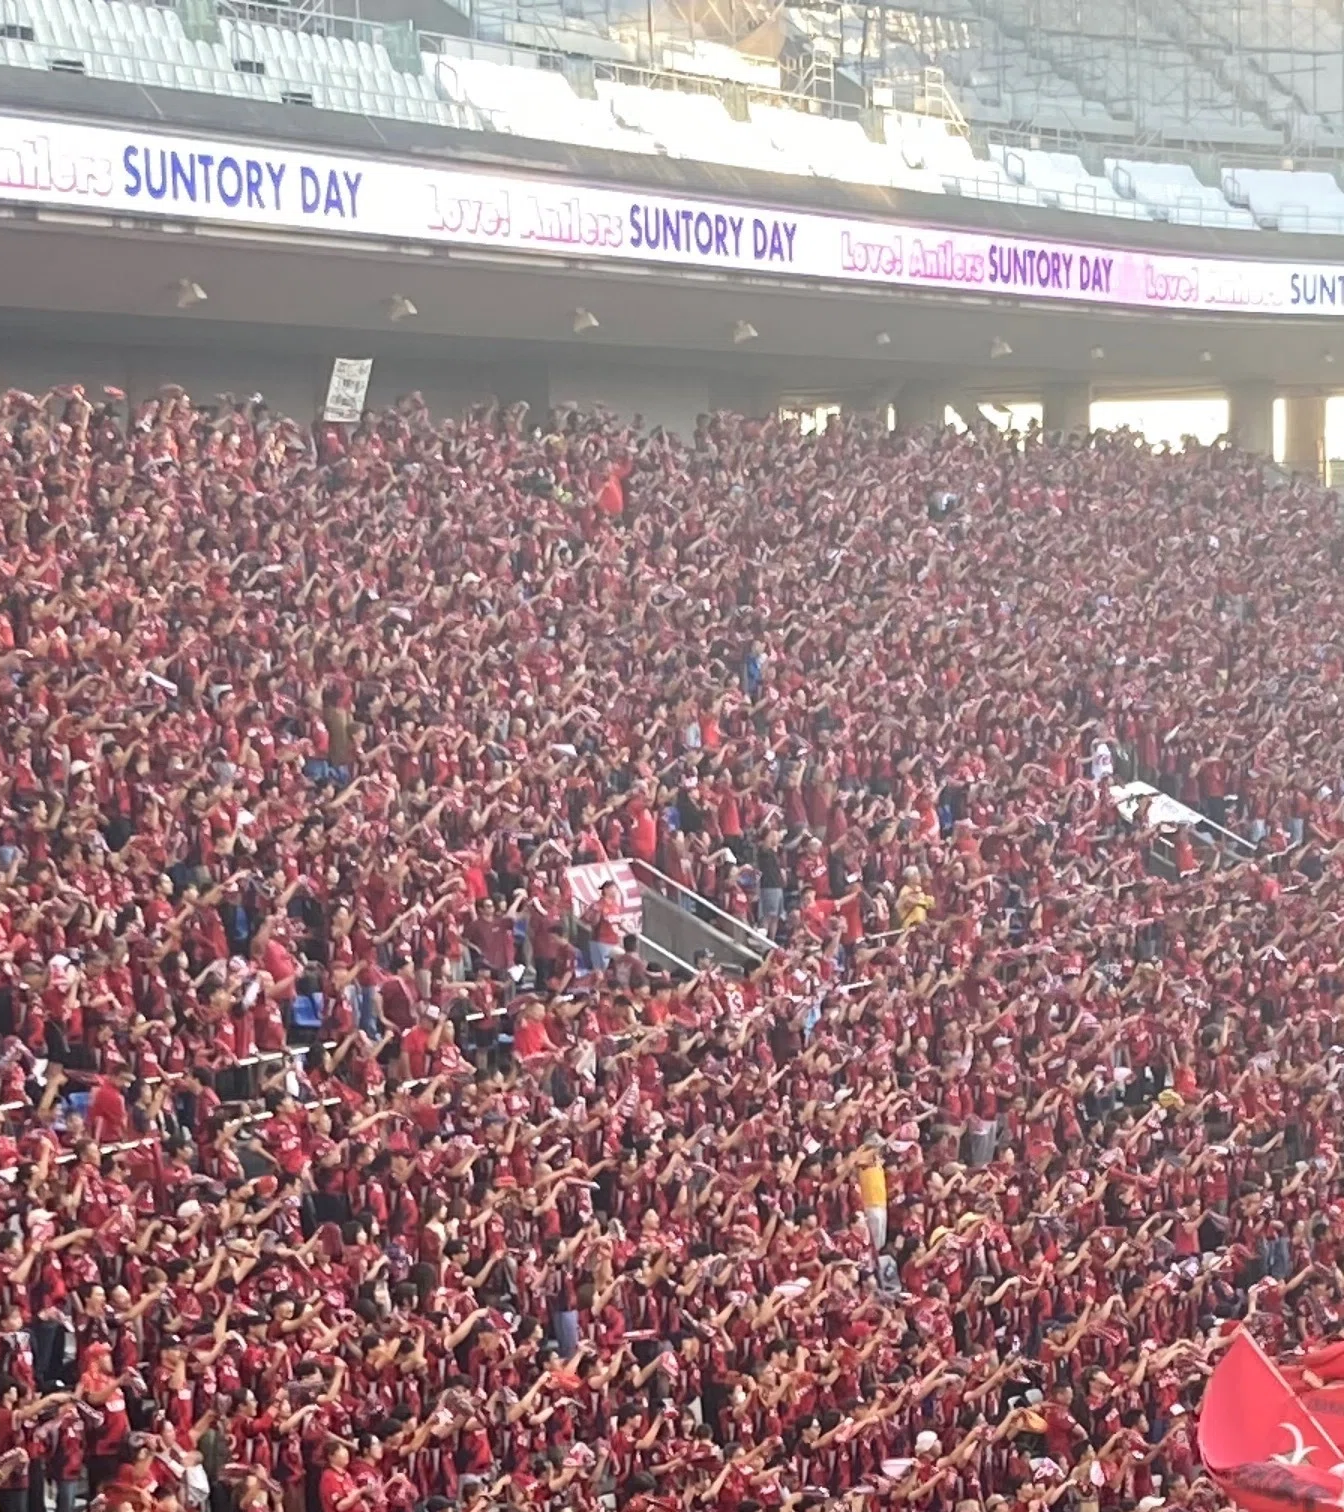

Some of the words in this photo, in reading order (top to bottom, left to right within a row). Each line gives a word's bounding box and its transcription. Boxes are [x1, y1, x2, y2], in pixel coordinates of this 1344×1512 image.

[122, 144, 285, 213] SUNTORY
[301, 168, 364, 221] DAY
[629, 203, 745, 258] SUNTORY
[753, 218, 798, 263] DAY
[987, 244, 1074, 289] SUNTORY
[1079, 255, 1114, 293] DAY
